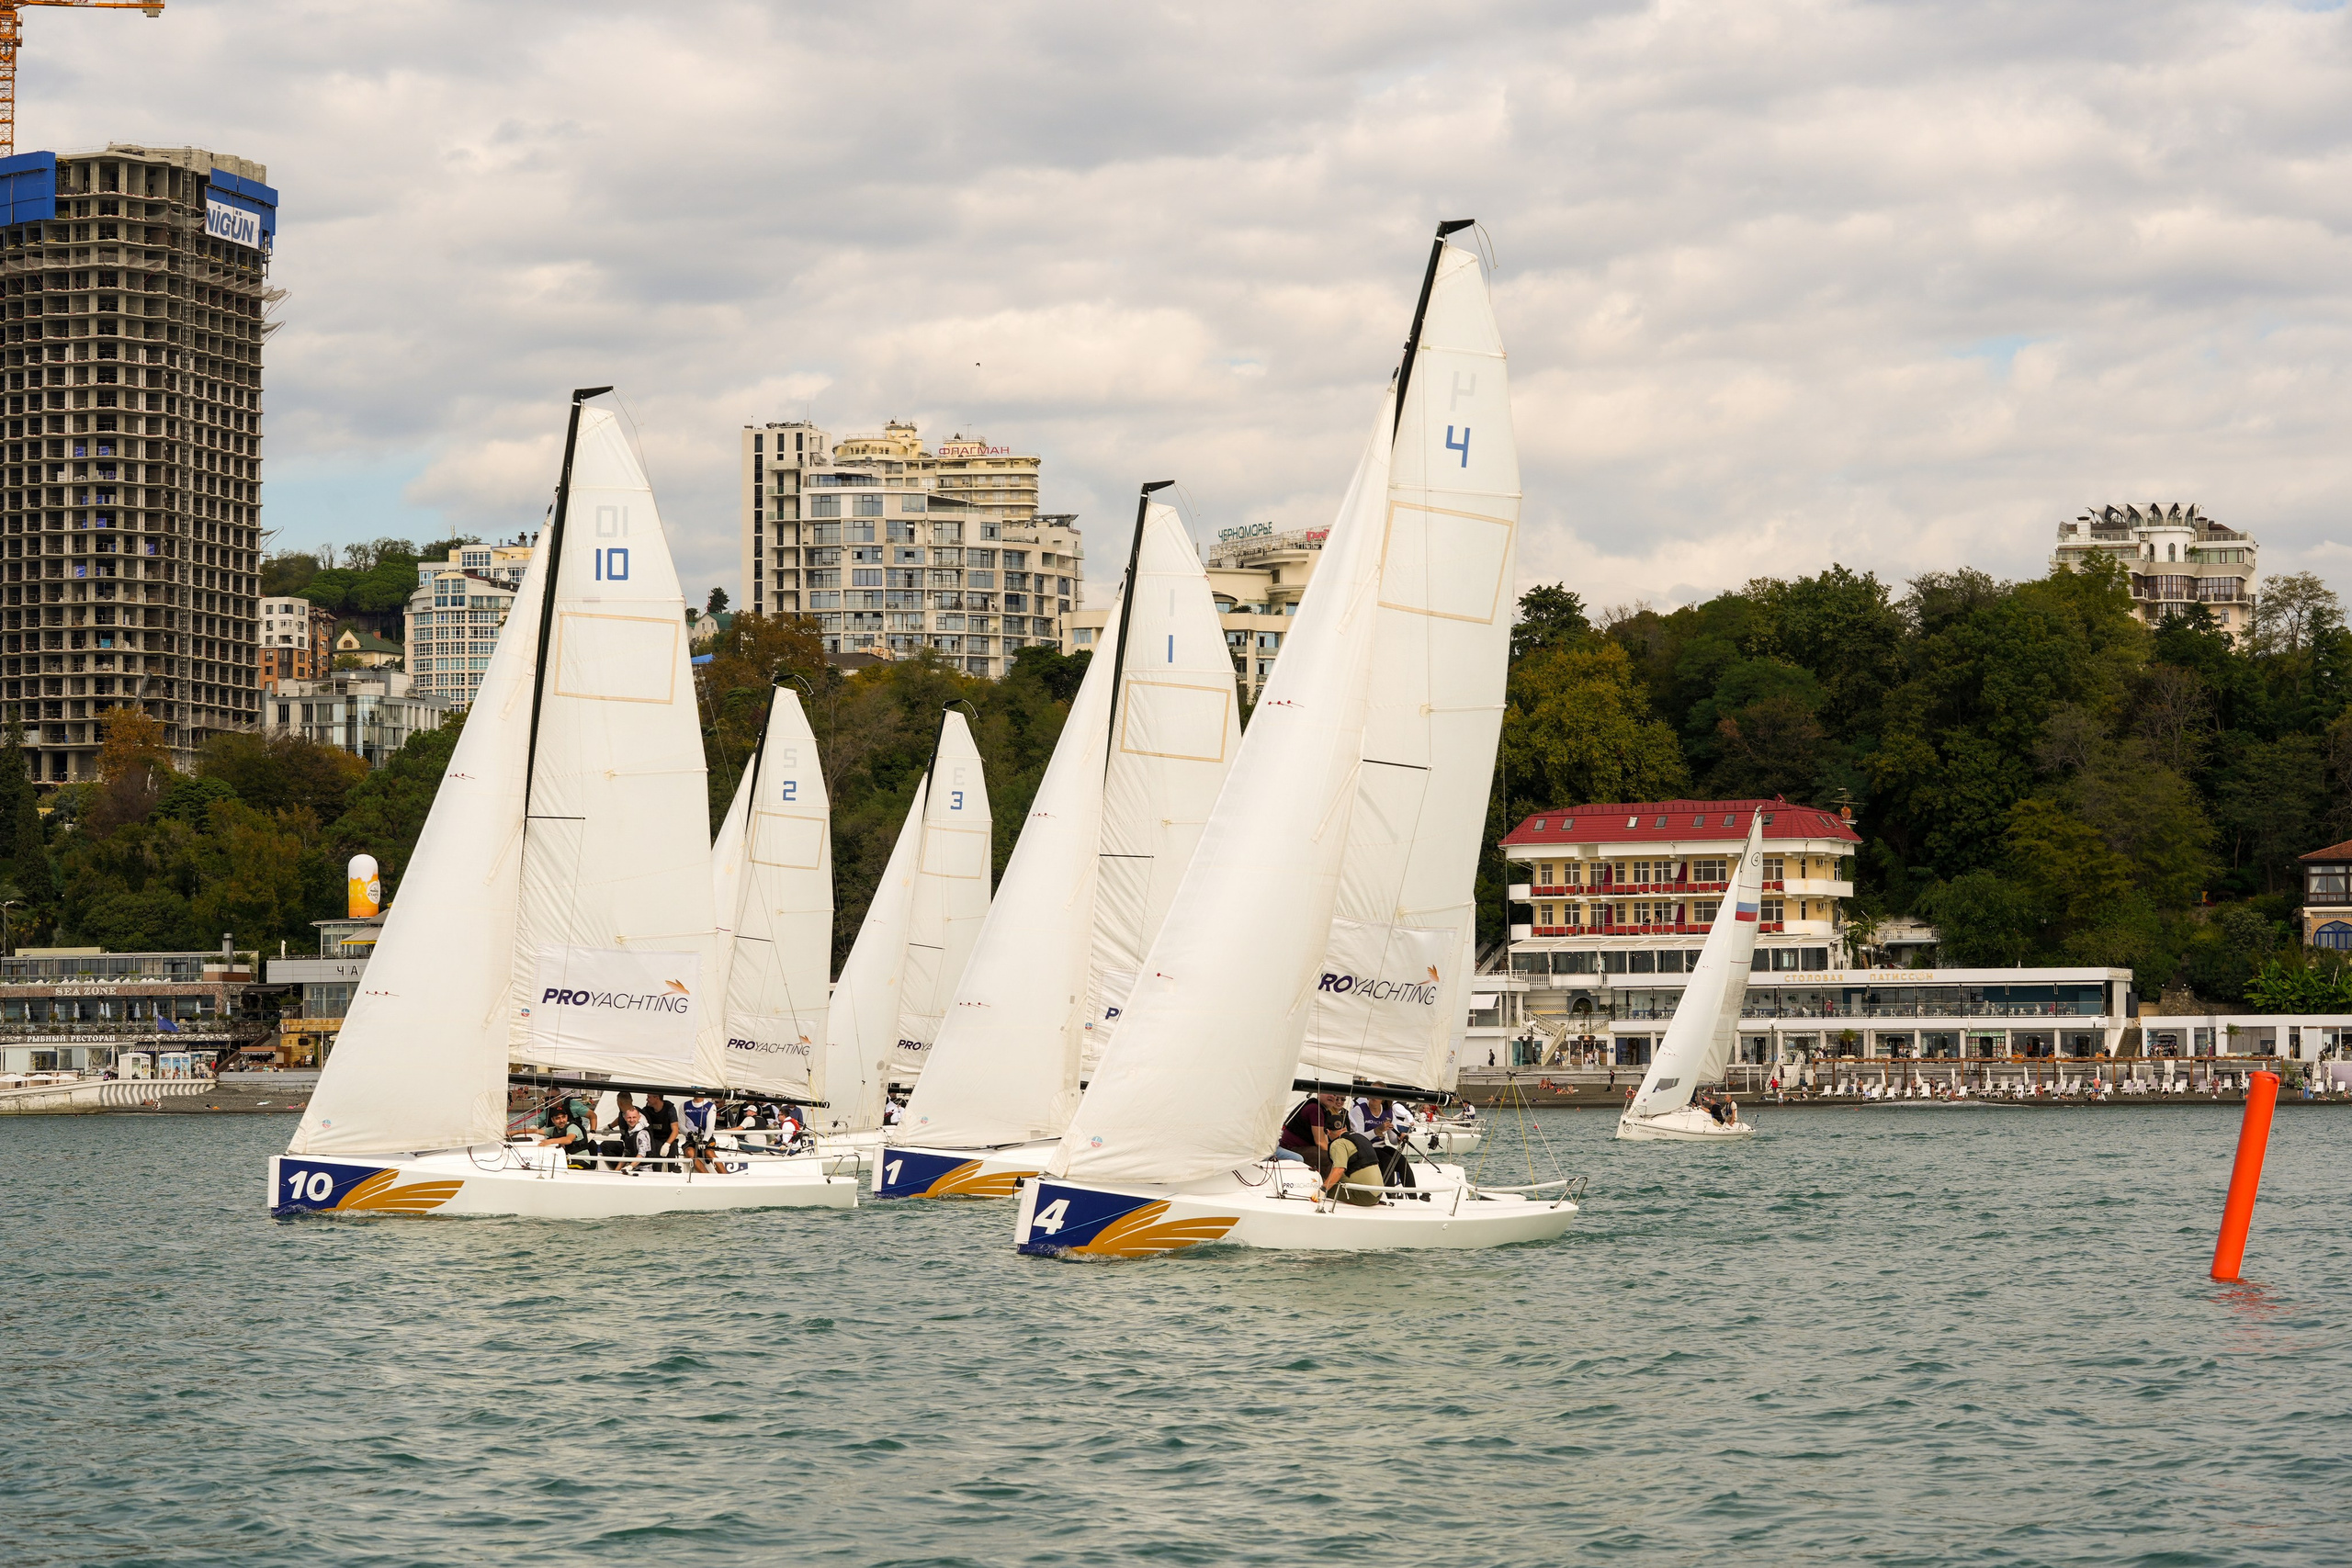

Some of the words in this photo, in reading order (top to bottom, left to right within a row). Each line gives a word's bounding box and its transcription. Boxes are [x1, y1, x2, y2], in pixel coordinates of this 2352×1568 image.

[938, 446, 1010, 456] ФЛАГМАН
[1445, 424, 1471, 468] 4
[1217, 521, 1272, 542] ЧЕРНОМОРЬЕ
[595, 547, 629, 581] 10
[783, 780, 797, 801] 2
[950, 791, 964, 810] 3
[1317, 972, 1437, 1006] ROYACHTING
[1784, 974, 1844, 983] СТОЛОВАЯ
[55, 987, 81, 996] SEA
[84, 987, 117, 995] ZONE
[541, 987, 689, 1014] PROYACHTING
[27, 1034, 66, 1043] РЫБНЫЙ
[70, 1034, 117, 1043] РЕСТОРАН
[727, 1038, 811, 1056] PROYACHTING
[885, 1158, 903, 1185] 1
[288, 1170, 334, 1201] 10
[1032, 1198, 1071, 1235] 4
